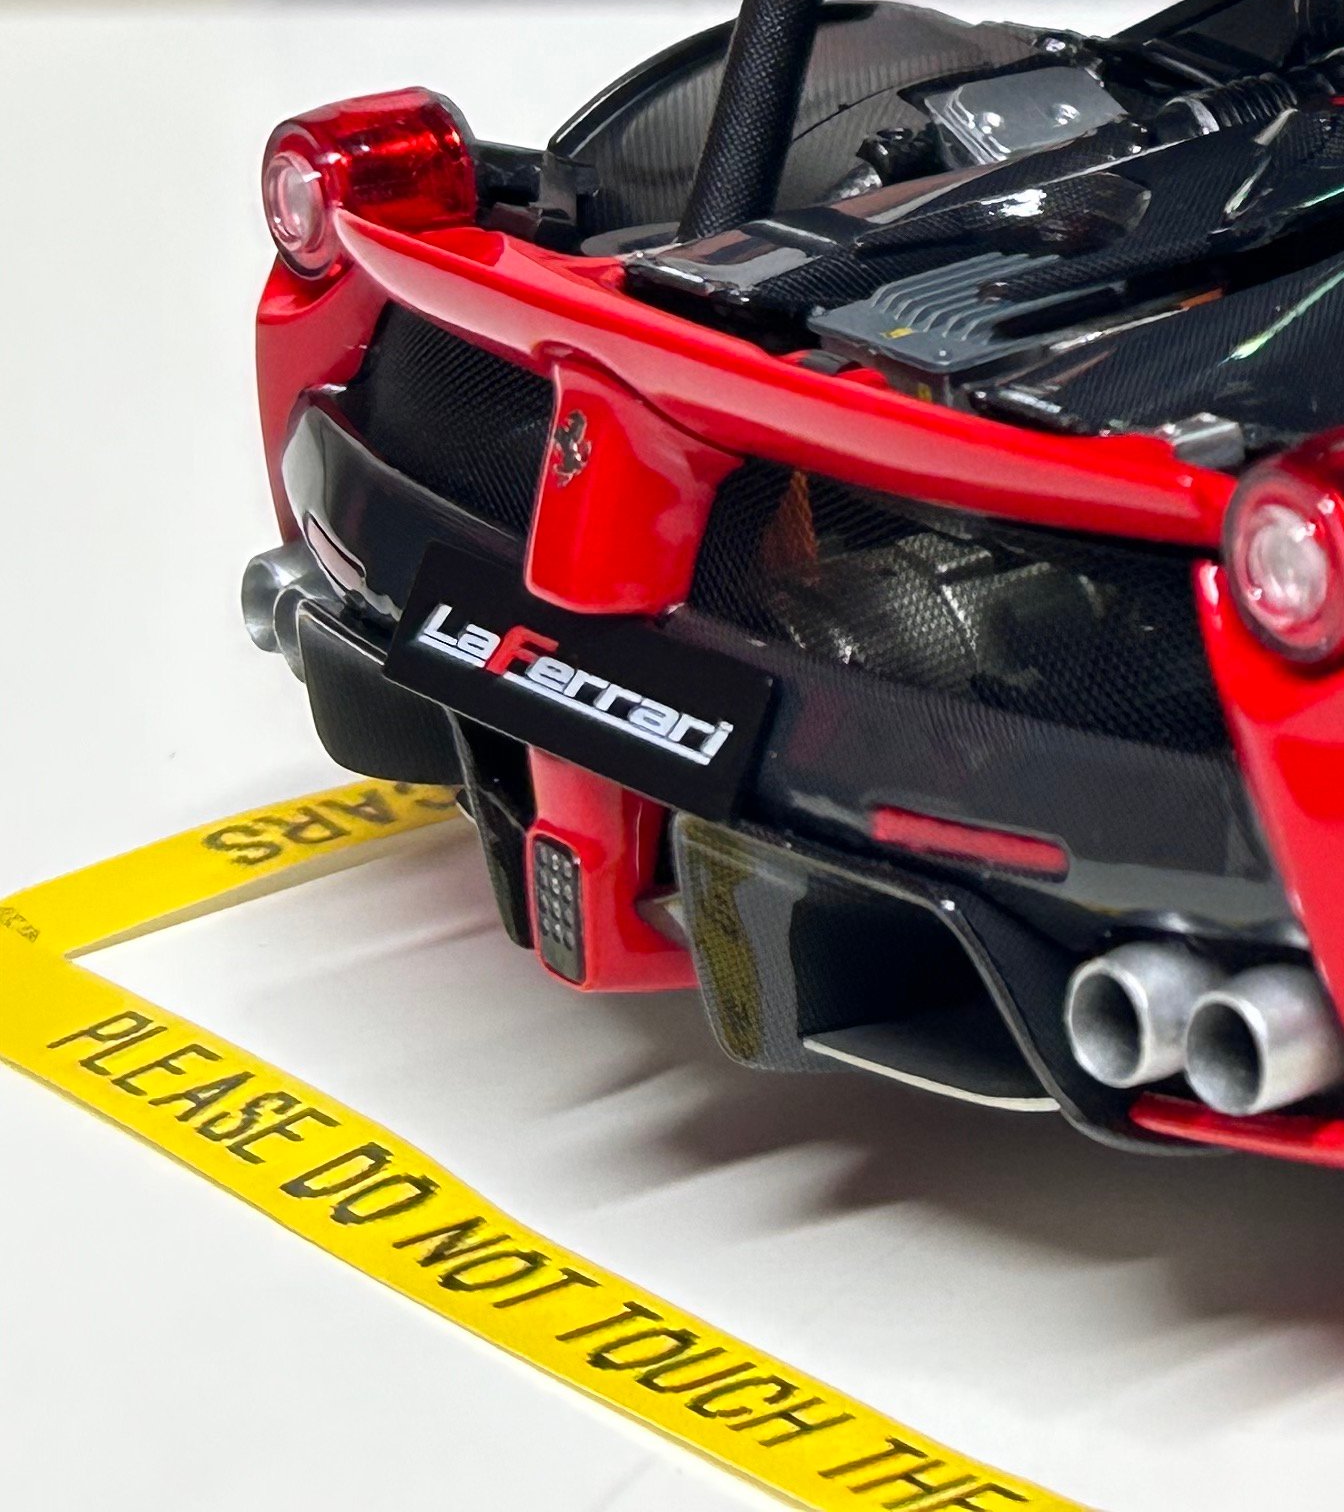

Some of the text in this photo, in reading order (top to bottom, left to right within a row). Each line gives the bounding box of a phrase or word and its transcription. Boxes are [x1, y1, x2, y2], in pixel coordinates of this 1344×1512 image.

[417, 602, 735, 766] LaFerrari
[46, 1009, 342, 1165] PLEASE
[279, 1140, 442, 1227] DO
[392, 1215, 600, 1310] NOT
[555, 1300, 857, 1449] TOUCH
